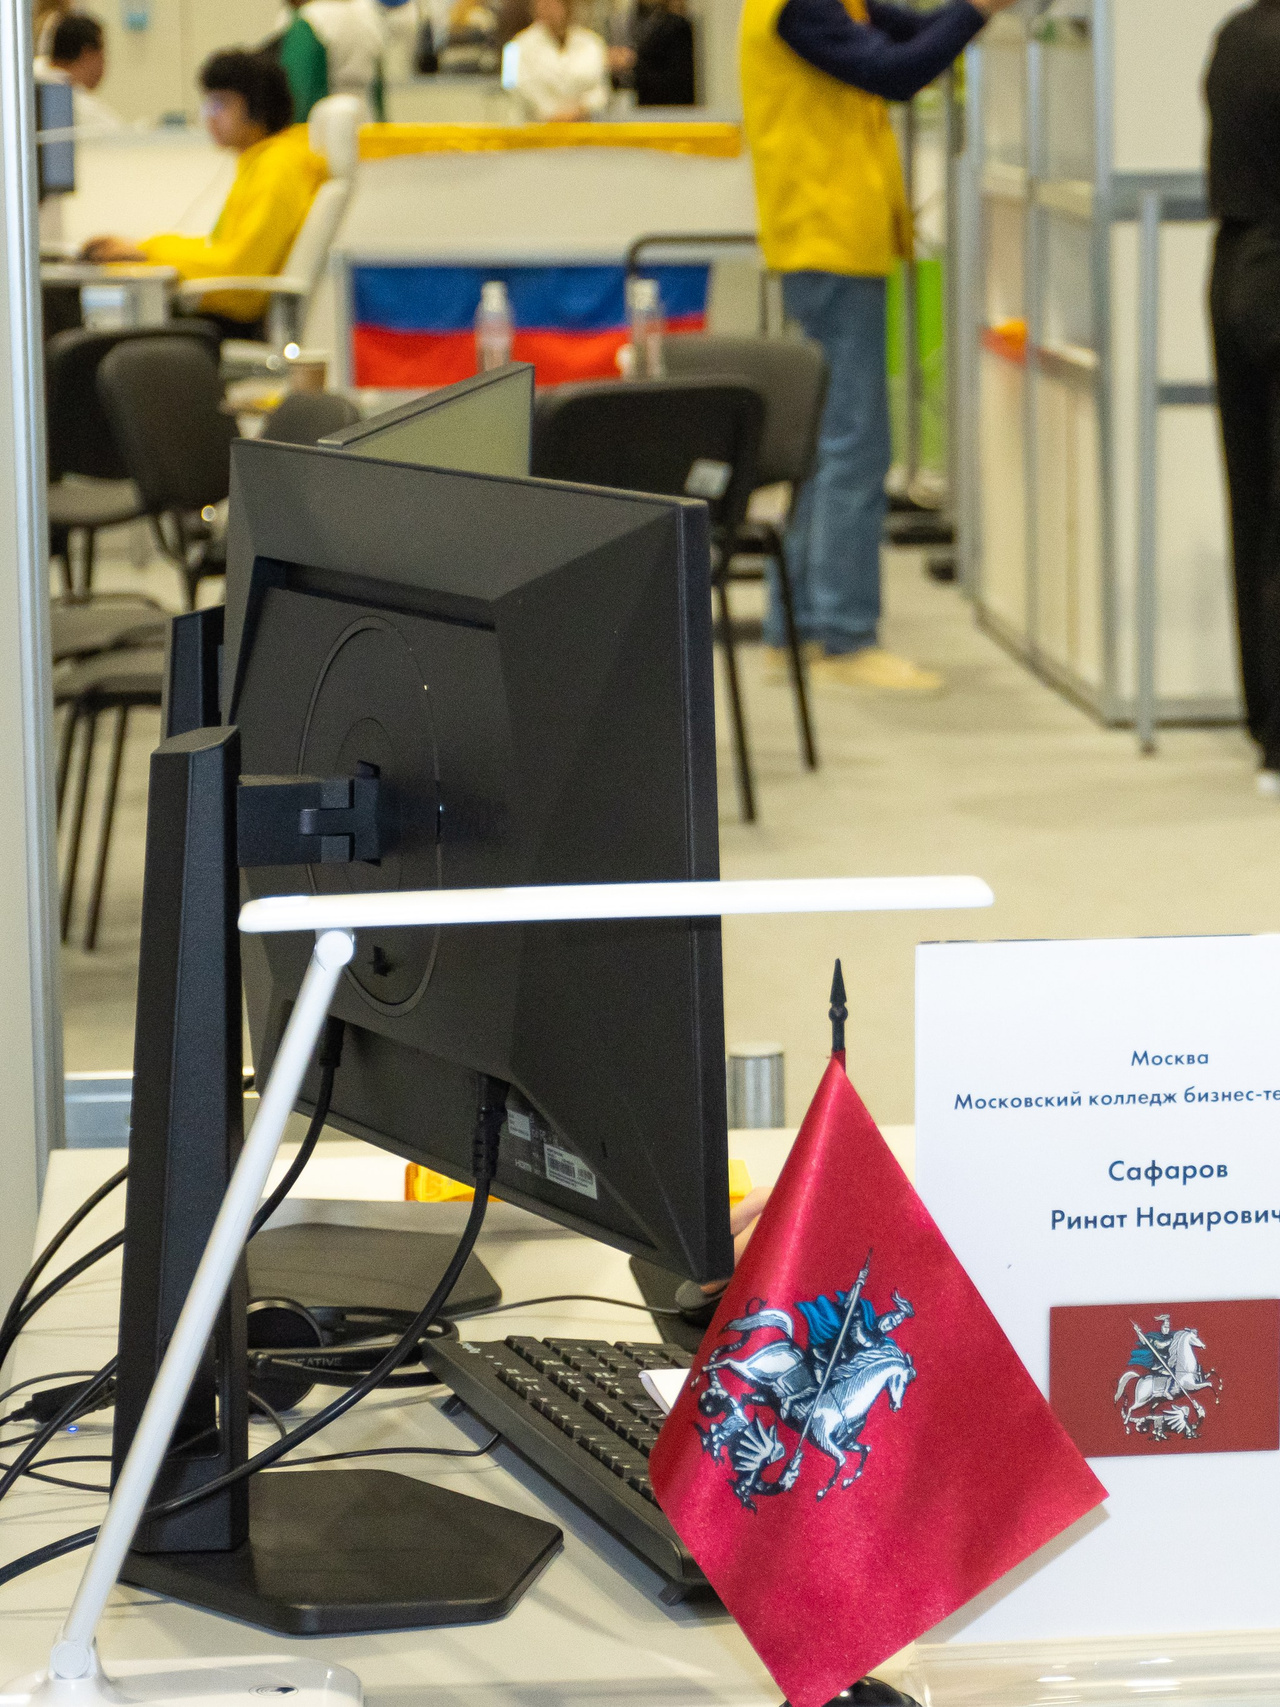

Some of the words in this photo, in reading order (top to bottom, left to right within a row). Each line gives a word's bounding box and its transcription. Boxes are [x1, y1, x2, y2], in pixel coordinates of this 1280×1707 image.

[1131, 1049, 1209, 1066] Москва
[954, 1091, 1082, 1110] Московский
[1088, 1092, 1177, 1107] колледж
[1108, 1159, 1228, 1187] Сафаров
[1051, 1209, 1128, 1230] Ринат
